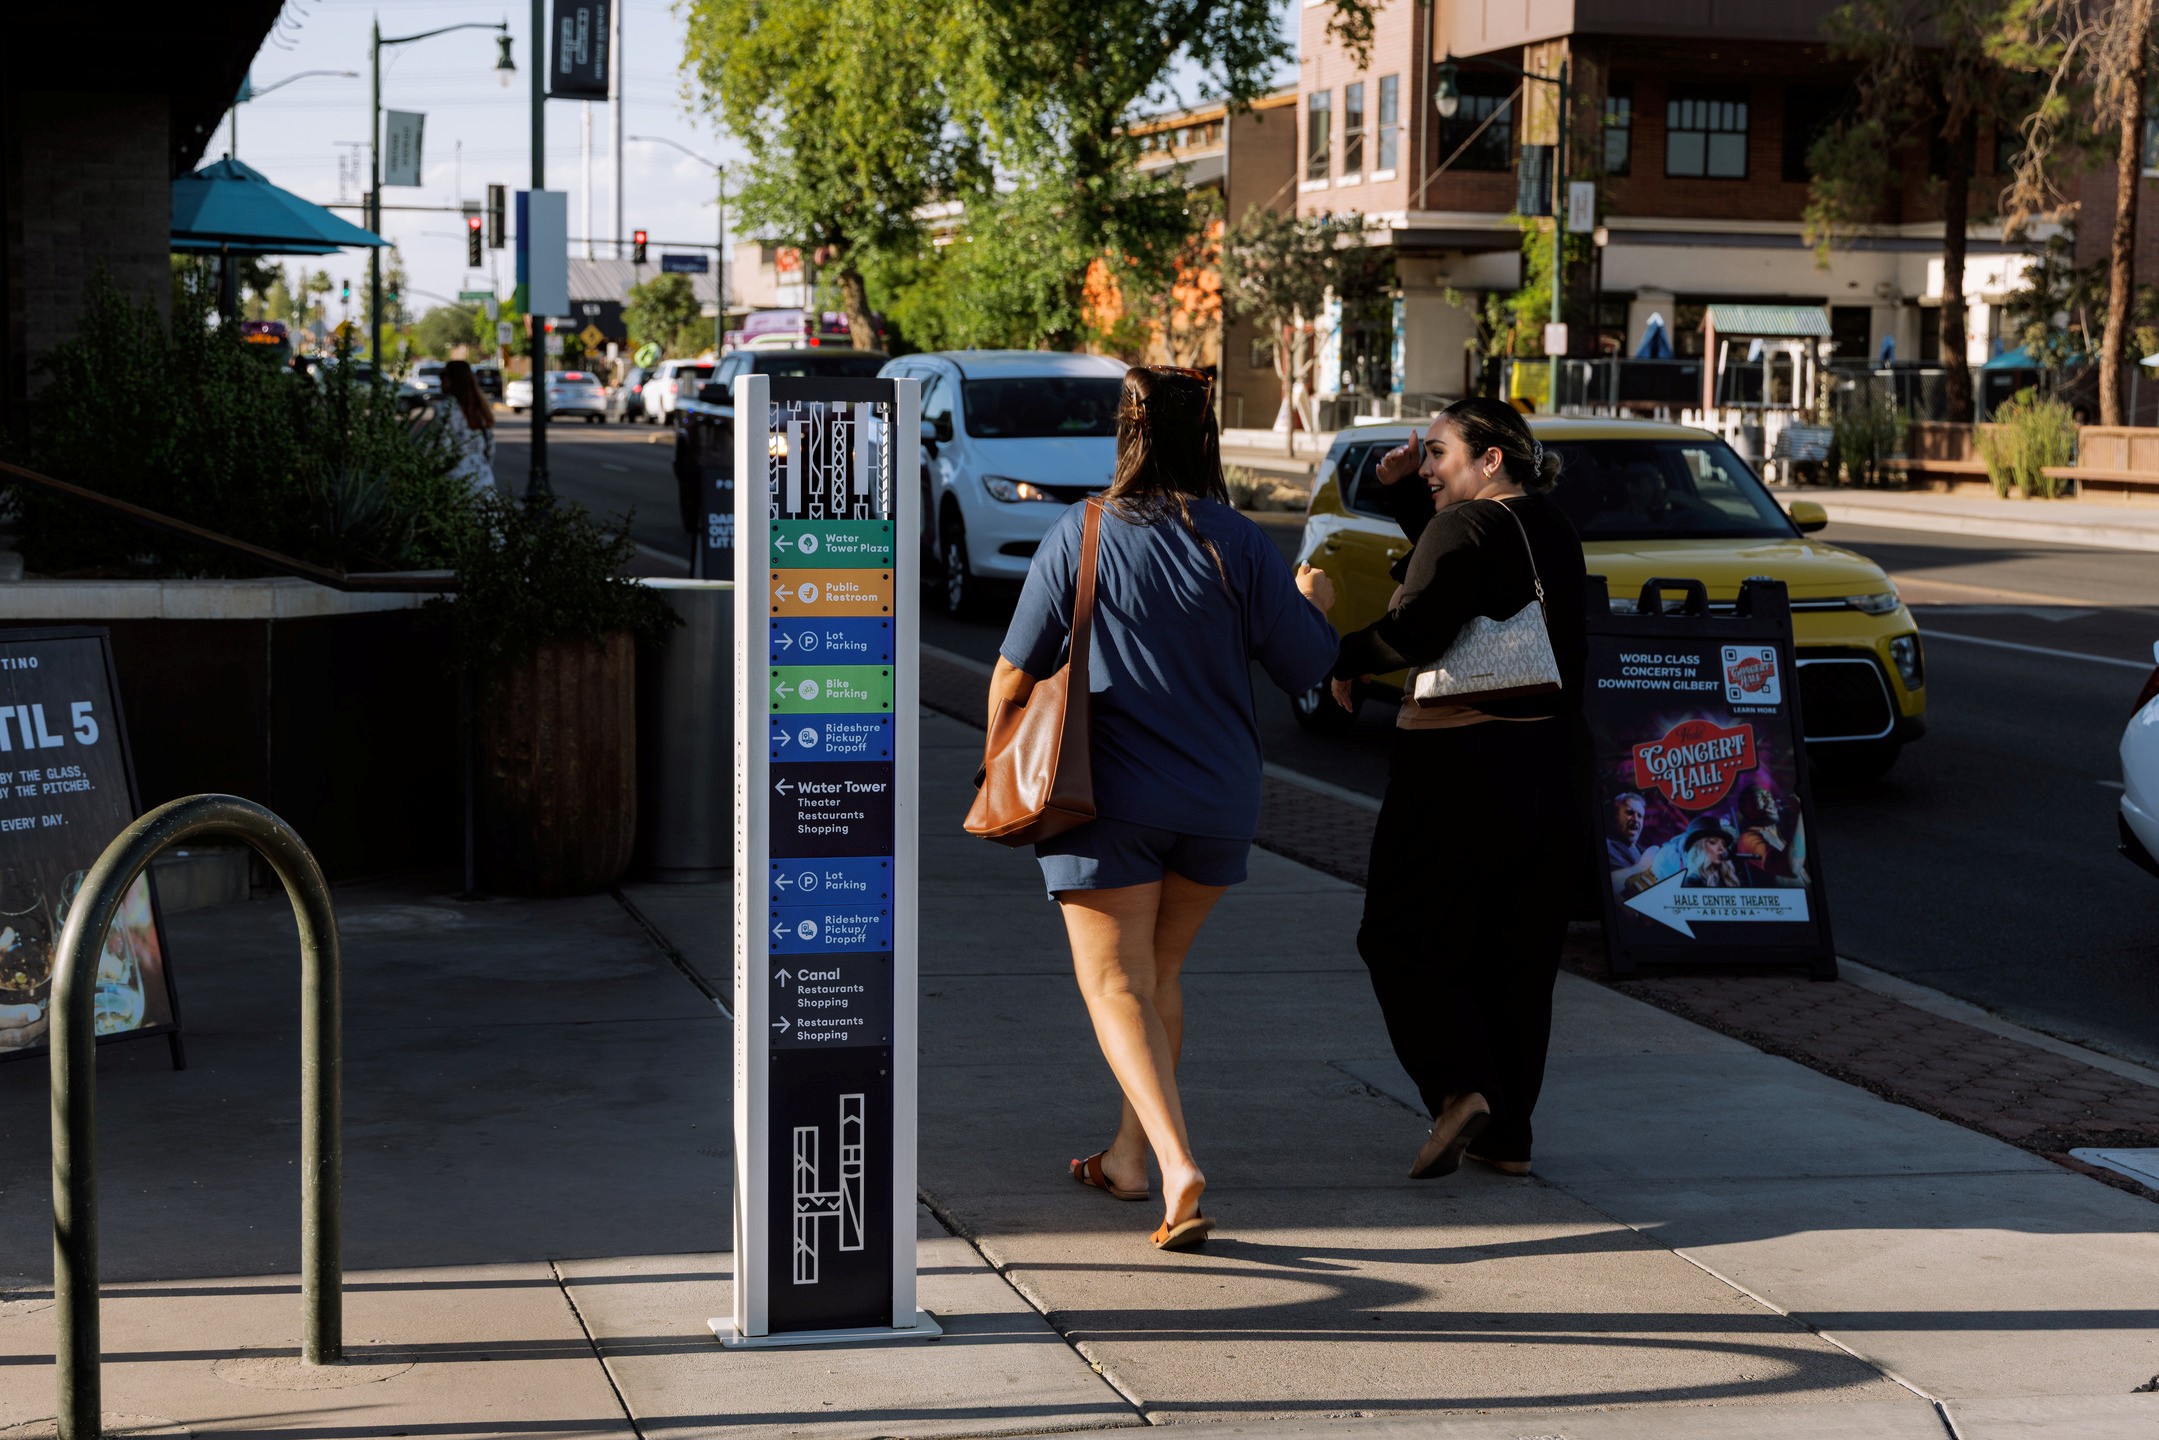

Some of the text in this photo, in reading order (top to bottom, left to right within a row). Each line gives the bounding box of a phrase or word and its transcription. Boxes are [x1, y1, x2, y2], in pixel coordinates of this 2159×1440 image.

[826, 534, 859, 543] Water
[826, 544, 889, 553] Tower Plaza
[826, 583, 859, 592] Public
[826, 593, 878, 602] Restroom
[826, 631, 843, 640] Lot
[826, 641, 867, 651] Parking
[1620, 654, 1700, 664] WORLD CLASS
[1622, 667, 1696, 677] CONCERTS IN
[826, 679, 849, 688] Bike
[1598, 679, 1719, 690] DOWNTOWN GILBERT
[826, 689, 867, 700] Parking
[71, 701, 99, 745] 5
[826, 724, 881, 732] Rideshare
[826, 733, 867, 744] Pickup/
[826, 743, 866, 753] Dropoff
[1639, 734, 1745, 774] CONCERT
[0, 766, 86, 784] BY THE GLASS,
[1663, 763, 1723, 800] HALL
[15, 785, 37, 797] THE
[43, 779, 95, 794] PITCHER.
[798, 781, 886, 793] Water Tower
[798, 798, 840, 807] Theater
[798, 811, 864, 820] Restaurants
[1, 814, 69, 831] EVERY DAY.
[798, 824, 849, 835] Shopping
[826, 871, 843, 880] Lot
[826, 880, 866, 890] Parking
[1674, 895, 1780, 906] HALE CENTRE THEATRE
[825, 915, 879, 924] Rideshare
[825, 925, 866, 936] Pickup/
[825, 935, 866, 945] Dropoff
[798, 968, 840, 980] Canal
[798, 985, 864, 994] Restaurants
[798, 998, 848, 1008] Shopping
[798, 1017, 863, 1027] Restaurants
[798, 1030, 848, 1041] Shopping
